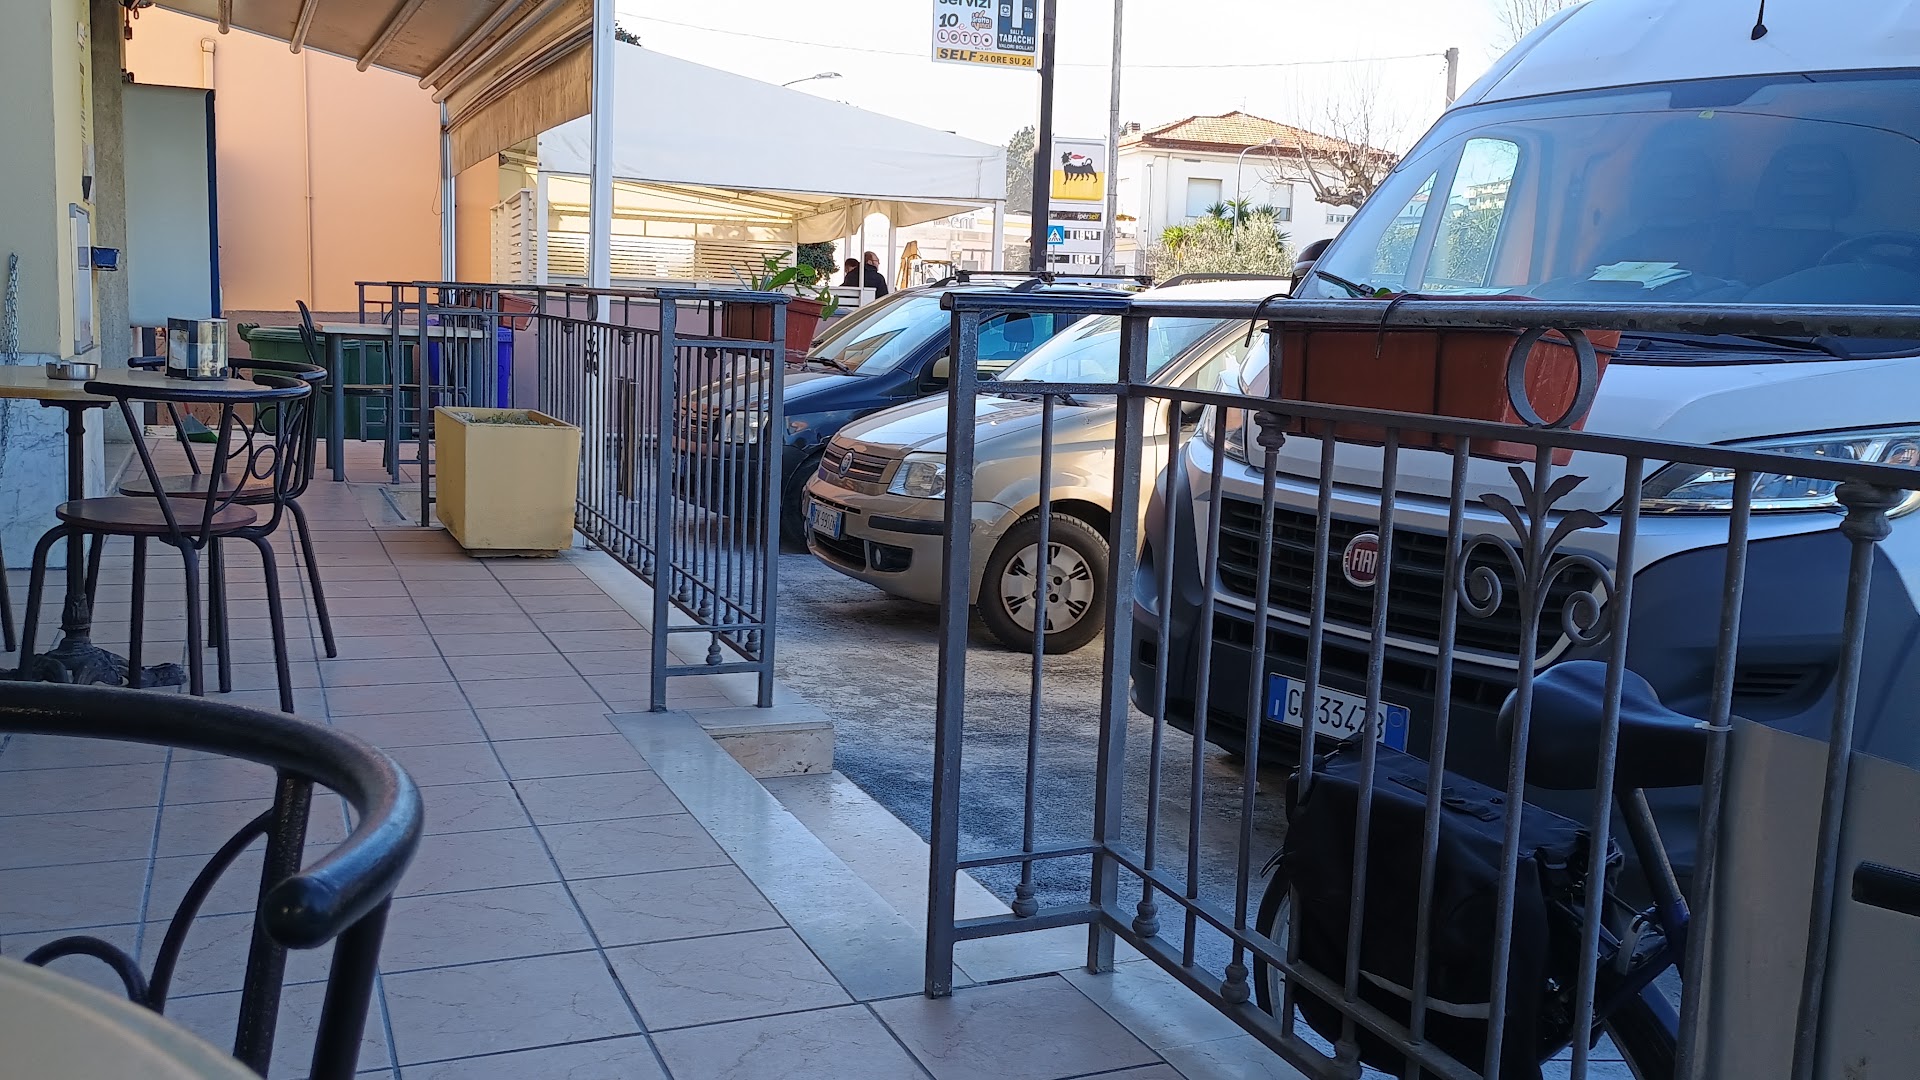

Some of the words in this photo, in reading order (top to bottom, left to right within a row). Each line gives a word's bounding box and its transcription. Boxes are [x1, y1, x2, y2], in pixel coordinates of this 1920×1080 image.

[939, 13, 959, 27] 10
[938, 30, 991, 45] LOTTO
[999, 34, 1034, 44] TABACCHI
[940, 48, 977, 61] SELF
[980, 54, 988, 62] 24
[991, 55, 1007, 64] ORE
[1010, 57, 1020, 65] SU
[1022, 58, 1031, 66] 24
[1351, 548, 1378, 574] FIAT
